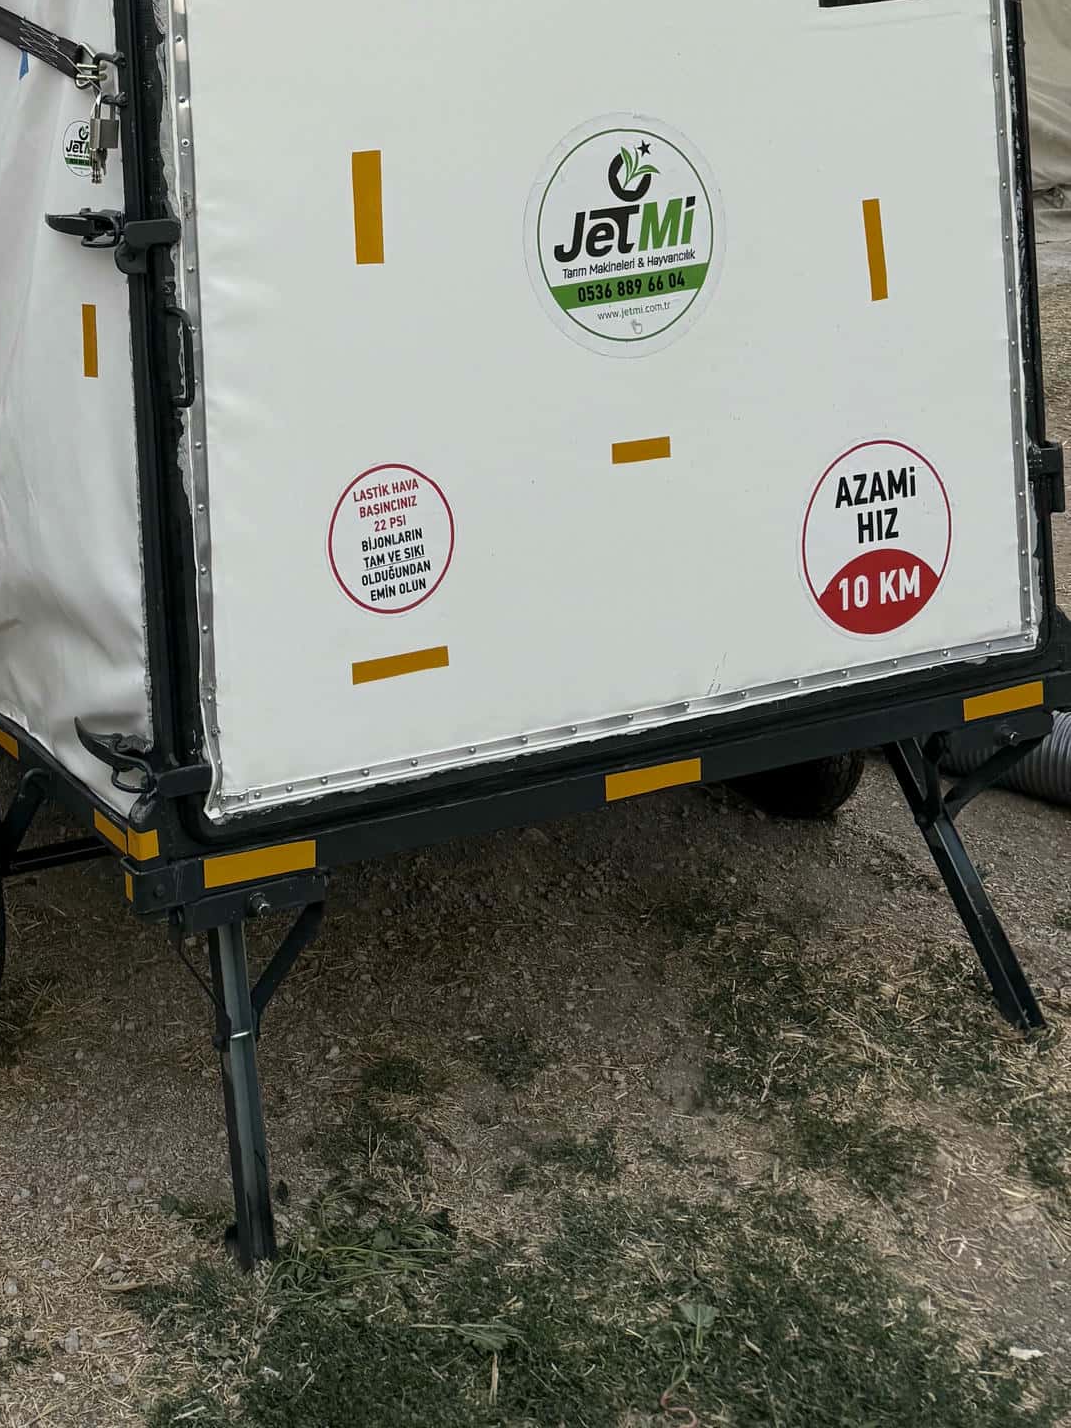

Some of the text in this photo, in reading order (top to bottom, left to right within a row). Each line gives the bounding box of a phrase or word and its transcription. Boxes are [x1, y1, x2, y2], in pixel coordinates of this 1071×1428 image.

[562, 249, 696, 280] Tarım Makineleri & Hayvancılık
[579, 272, 685, 302] 0536 889 66 04
[597, 301, 670, 321] www.jetmi.com.tr
[354, 479, 419, 502] LASTİK HAVA
[359, 495, 417, 518] BASINCINIZ
[374, 515, 406, 532] 22 PSI
[857, 508, 898, 543] HIZ
[362, 528, 423, 552] BİJONLARIN
[363, 544, 424, 569] TAM VE SIKI
[362, 560, 431, 586] OLDUĞUNDAN
[371, 578, 426, 601] EMİN OLUN
[839, 565, 920, 610] 10 KM
